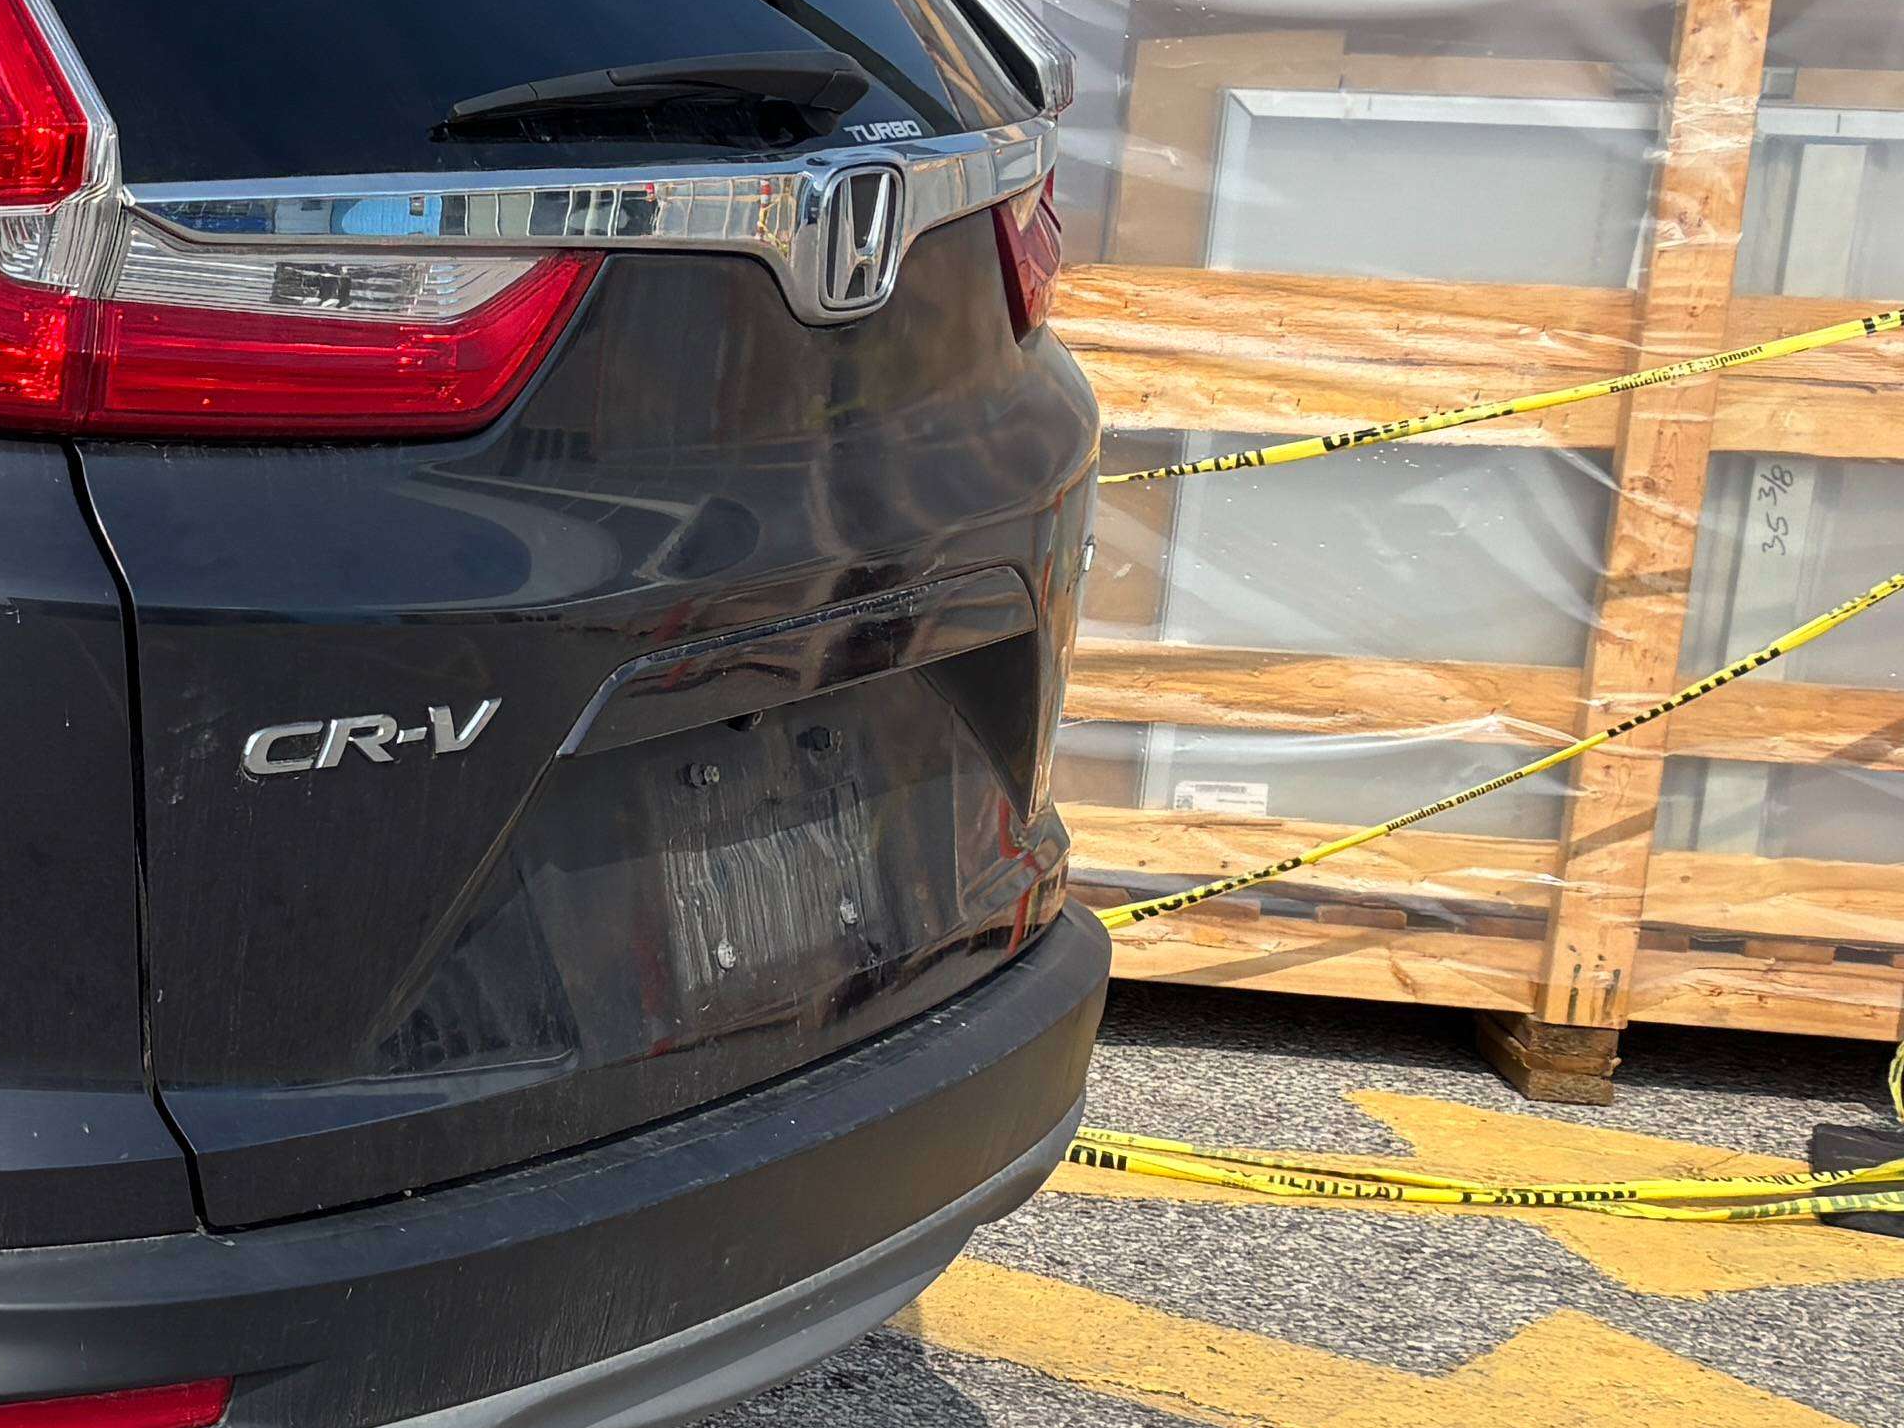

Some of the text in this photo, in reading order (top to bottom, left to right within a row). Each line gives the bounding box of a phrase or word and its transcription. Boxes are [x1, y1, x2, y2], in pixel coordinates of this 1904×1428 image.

[843, 120, 923, 143] TURBO
[1757, 463, 1794, 557] 35 3/8
[243, 698, 503, 775] CR-V
